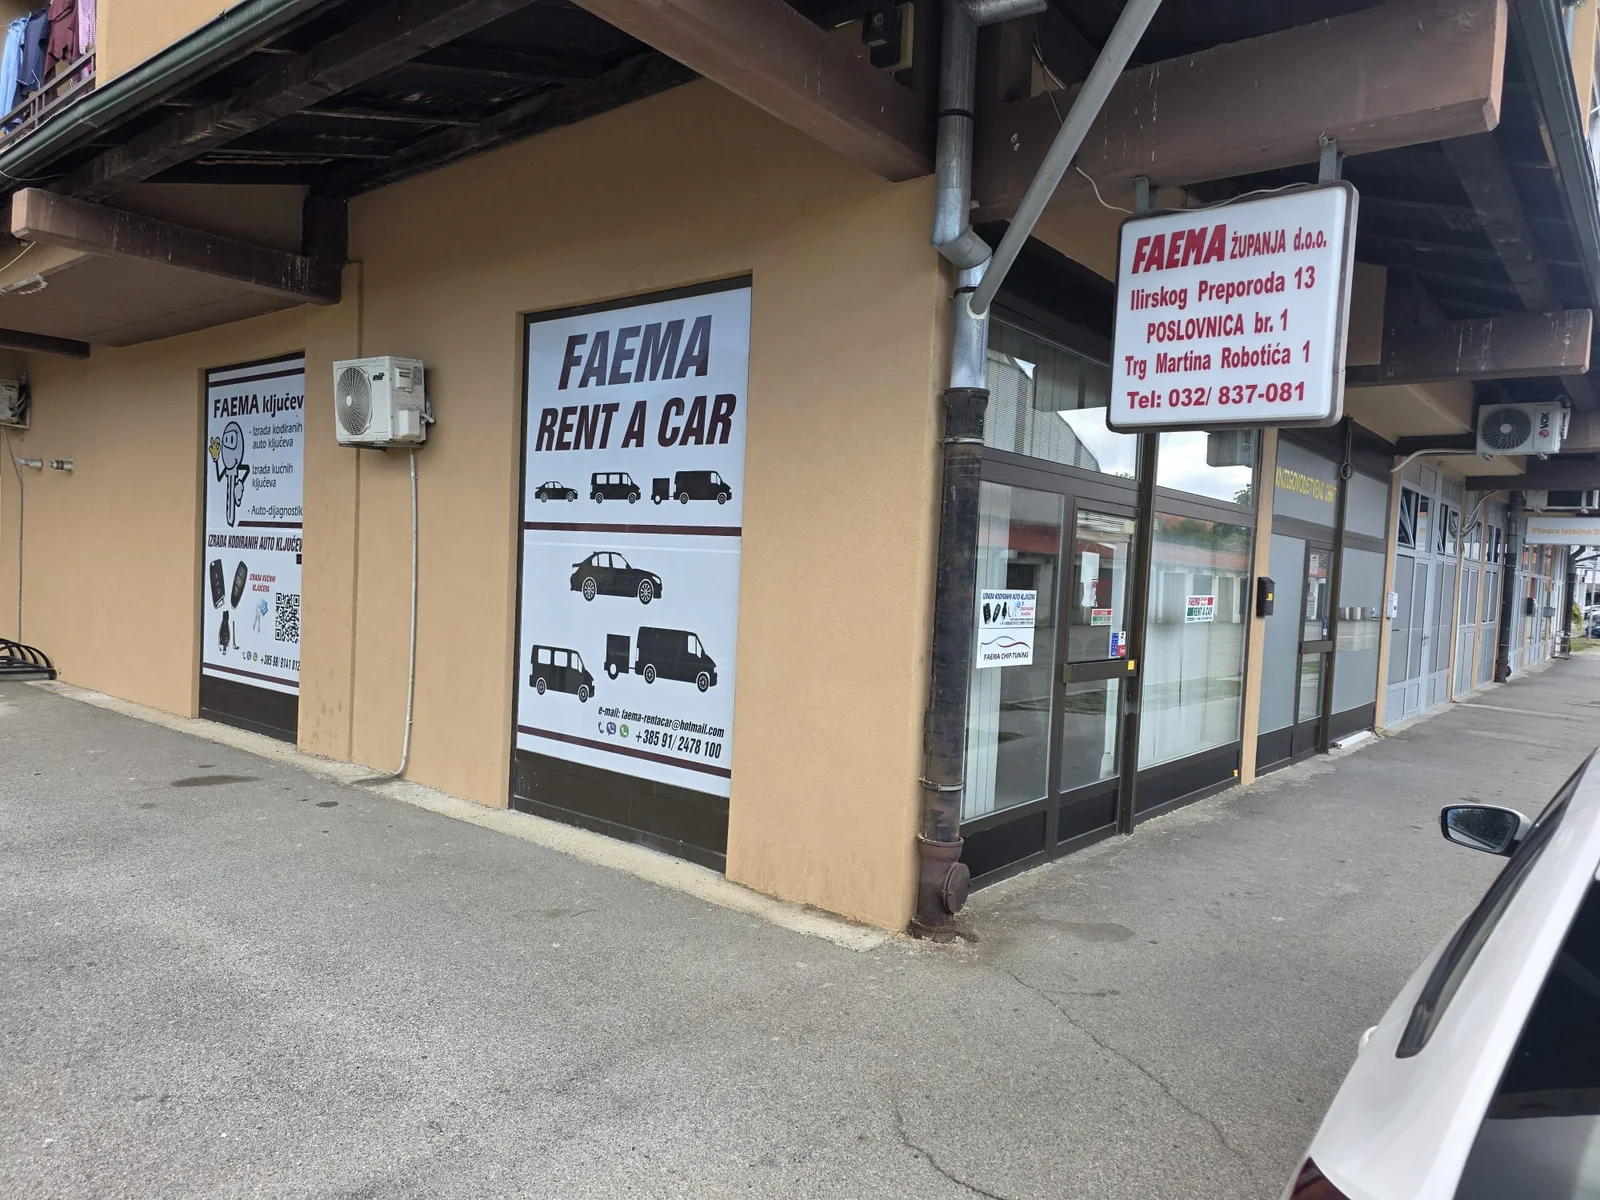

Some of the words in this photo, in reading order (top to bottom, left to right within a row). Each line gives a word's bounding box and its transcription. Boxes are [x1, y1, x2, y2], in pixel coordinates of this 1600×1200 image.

[1131, 223, 1227, 275] FAEMA
[1230, 229, 1286, 260] ŽUPANJA
[1293, 227, 1327, 251] d.o.o.
[1130, 286, 1188, 311] Ilirskog
[1197, 271, 1285, 304] Preporoda
[1293, 265, 1316, 290] 13
[1146, 313, 1244, 344] POSLOVNICA
[1254, 311, 1274, 334] br.
[1280, 308, 1288, 331] 1
[558, 314, 712, 390] FAEMA
[1125, 355, 1147, 380] Trg
[1155, 350, 1211, 374] Martina
[1220, 342, 1291, 369] Robotića
[1302, 340, 1311, 363] 1
[213, 393, 260, 419] FAEMA
[262, 392, 304, 418] ključev
[1127, 390, 1162, 410] Tel:
[1168, 386, 1212, 408] 032/
[1218, 381, 1305, 405] 837-081
[252, 425, 271, 436] Izrada
[272, 423, 303, 436] kodiranih
[535, 402, 620, 452] RENT
[621, 400, 647, 448] A
[657, 393, 737, 448] CAR
[1540, 412, 1550, 430] VOX
[252, 440, 267, 449] auto
[268, 437, 293, 451] ključeva
[252, 464, 271, 475] Izrada
[272, 463, 293, 474] kućnih
[252, 477, 277, 491] ključeva
[207, 534, 227, 548] IZRADA
[227, 534, 259, 550] KODIRANIH
[258, 536, 275, 551] AUTO
[597, 706, 621, 719] e-mail:
[621, 708, 725, 738] faema-rentacar@hotmail.com
[635, 729, 660, 746] +385
[661, 732, 678, 751] 91/
[677, 736, 701, 755] 2478
[704, 741, 722, 759] 100
